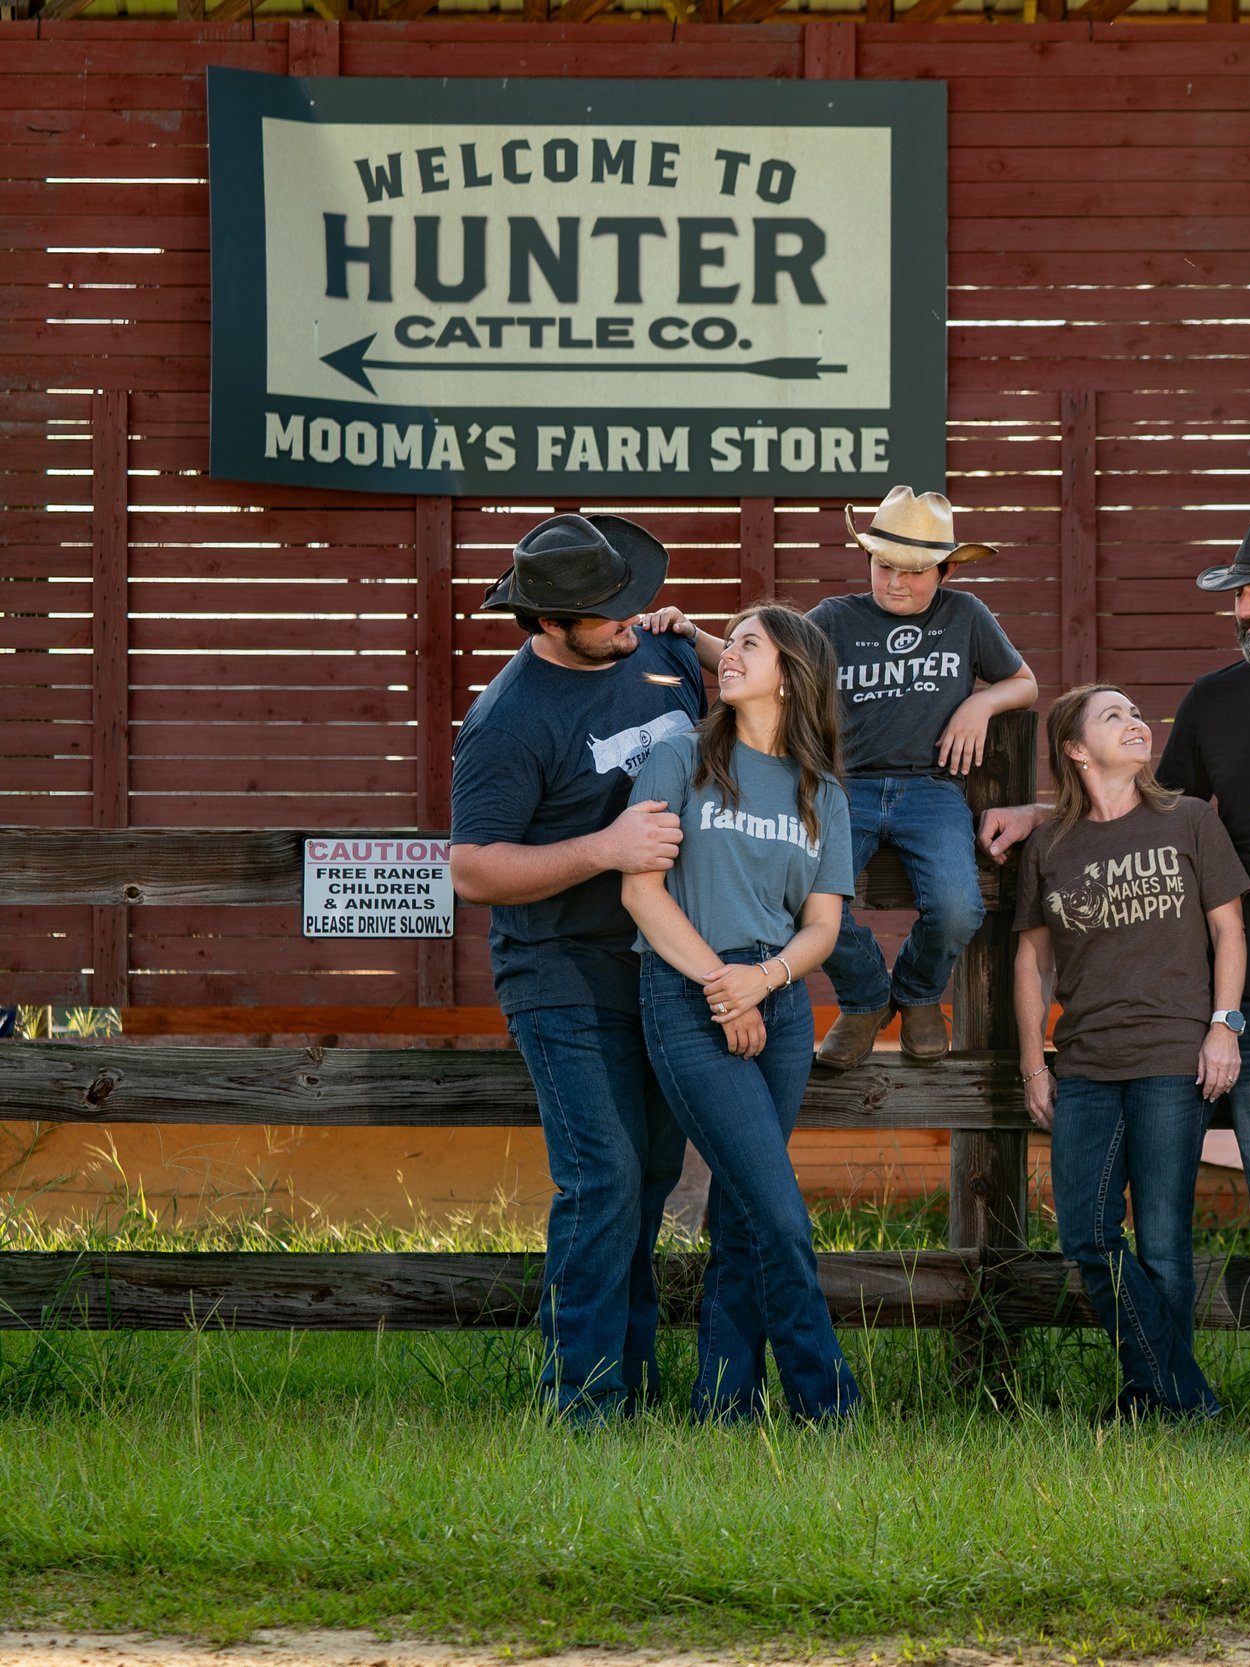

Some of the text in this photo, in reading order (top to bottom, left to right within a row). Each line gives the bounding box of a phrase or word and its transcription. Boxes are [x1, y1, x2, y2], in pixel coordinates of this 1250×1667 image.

[354, 137, 797, 205] WELCOME TO
[322, 212, 828, 305] HUNTER
[394, 315, 753, 350] CATTLE CO.
[263, 412, 890, 474] MOOMA'S FARM STORE
[836, 652, 961, 691] HUNTER
[853, 688, 911, 703] CATTL
[914, 681, 940, 692] CO.
[308, 842, 451, 861] CAUTION
[316, 868, 443, 880] FREE RANGE
[1107, 845, 1180, 886] MUD
[328, 883, 430, 895] CHILDREN
[1107, 876, 1184, 902] MAKES ME
[324, 898, 435, 910] & ANIMALS
[1110, 895, 1185, 927] HAPPY
[306, 916, 450, 934] PLEASE DRIVE SLOWLY
